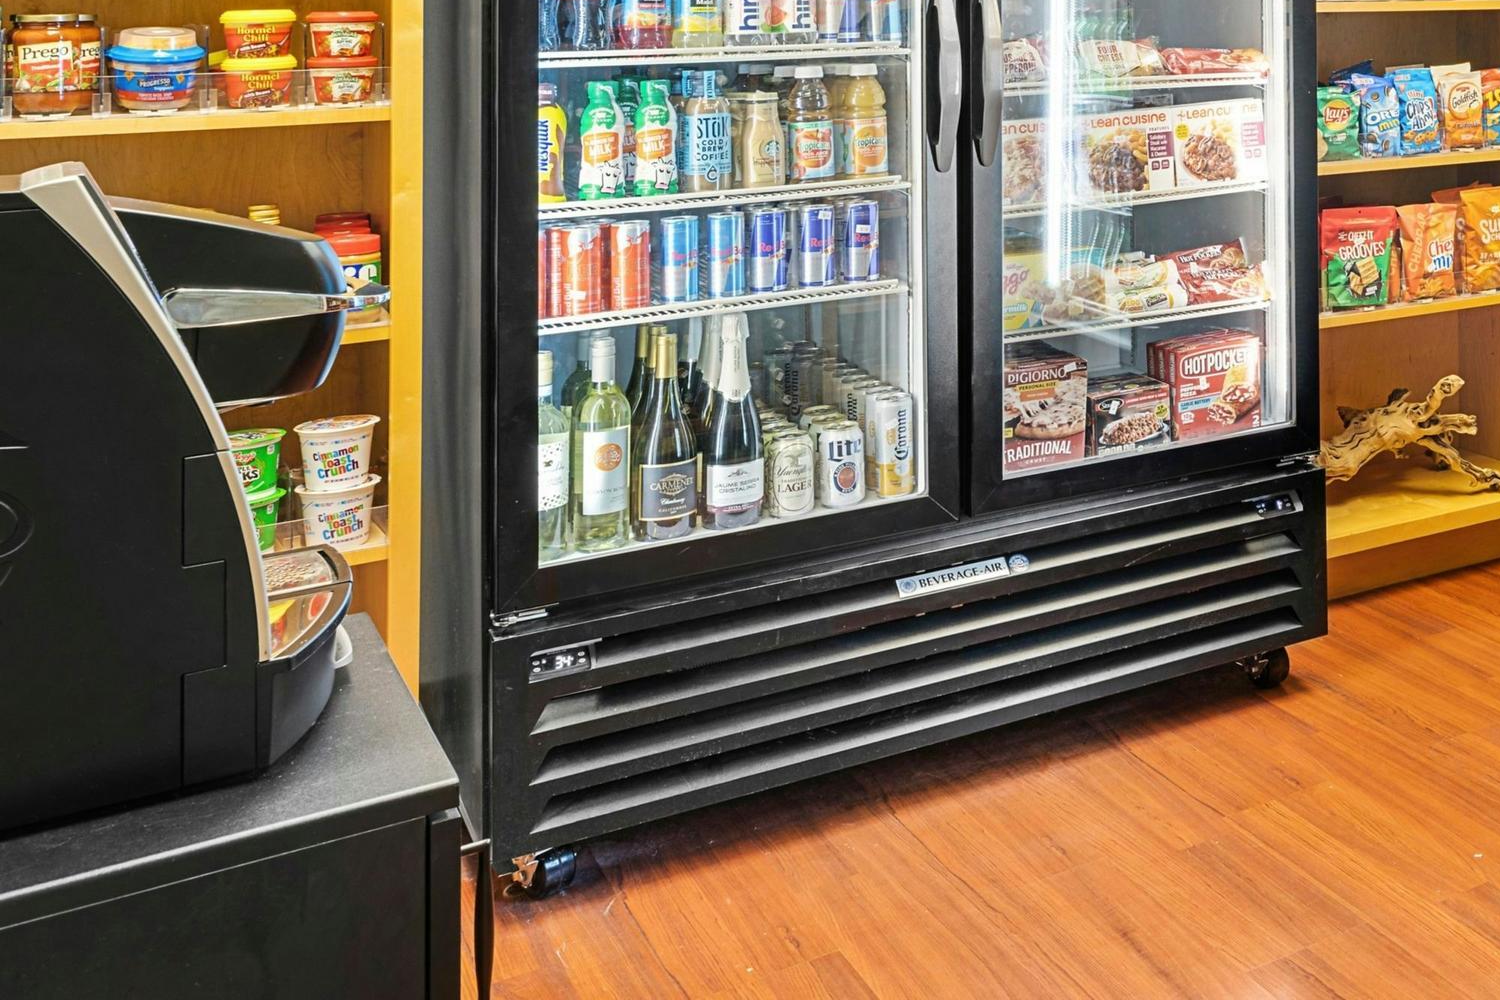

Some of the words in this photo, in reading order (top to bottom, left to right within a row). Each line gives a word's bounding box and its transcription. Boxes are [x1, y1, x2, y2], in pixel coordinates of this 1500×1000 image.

[236, 26, 276, 37] Hormel
[243, 34, 269, 43] Chili
[21, 46, 69, 61] Prego
[139, 77, 171, 91] PROGRESSO
[241, 71, 280, 83] Hormel
[247, 80, 273, 91] Chili
[1451, 91, 1479, 110] Goldfish
[1091, 117, 1121, 133] Lean
[1123, 112, 1168, 130] cuisine
[1323, 103, 1351, 124] Lay's
[1338, 241, 1384, 262] GROOVES
[1407, 212, 1426, 273] CHEDDAR
[1007, 367, 1066, 384] DIGIORNO
[1184, 359, 1210, 377] HOT
[1018, 384, 1044, 392] PERSONAL
[1253, 416, 1261, 426] 2
[894, 408, 909, 460] Corona
[828, 438, 862, 463] Lite
[1003, 440, 1071, 465] TRADITIONAL
[918, 561, 1003, 589] BEVERAGE-AIR
